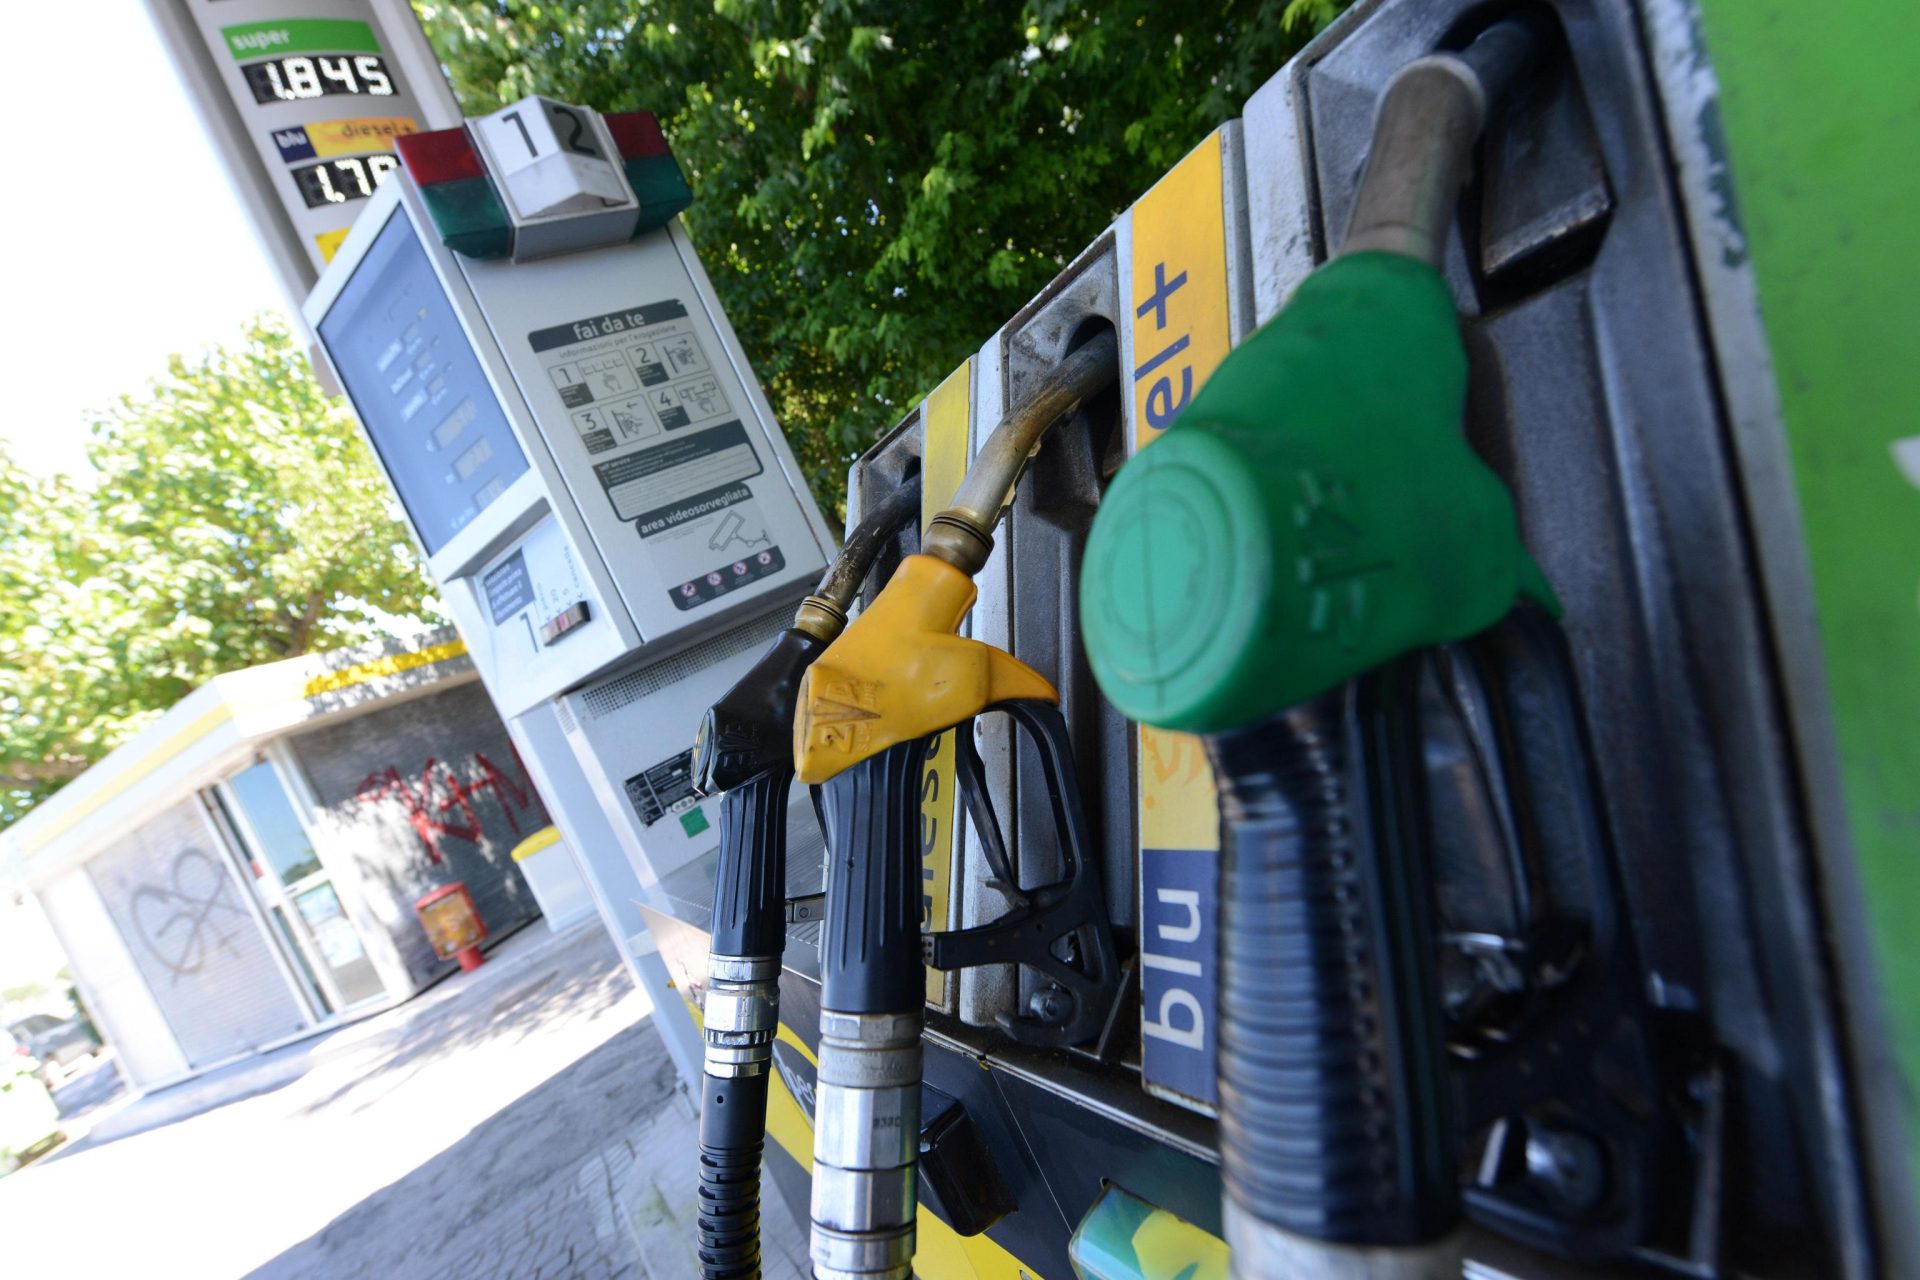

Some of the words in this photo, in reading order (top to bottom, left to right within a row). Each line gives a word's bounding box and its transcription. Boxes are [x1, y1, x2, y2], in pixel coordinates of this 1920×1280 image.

[231, 29, 290, 50] super
[264, 56, 392, 100] 1.845
[275, 130, 307, 149] blu
[501, 111, 538, 158] 1
[552, 106, 594, 155] 2
[573, 320, 599, 340] fai
[601, 316, 625, 333] da
[625, 313, 645, 328] te
[636, 347, 651, 364] 2
[559, 367, 572, 384] 1
[659, 391, 672, 407] 4
[581, 412, 597, 430] 3
[640, 518, 666, 534] area
[666, 487, 750, 525] videosorvegliata
[520, 611, 539, 653] 1
[1143, 888, 1205, 1051] blu
